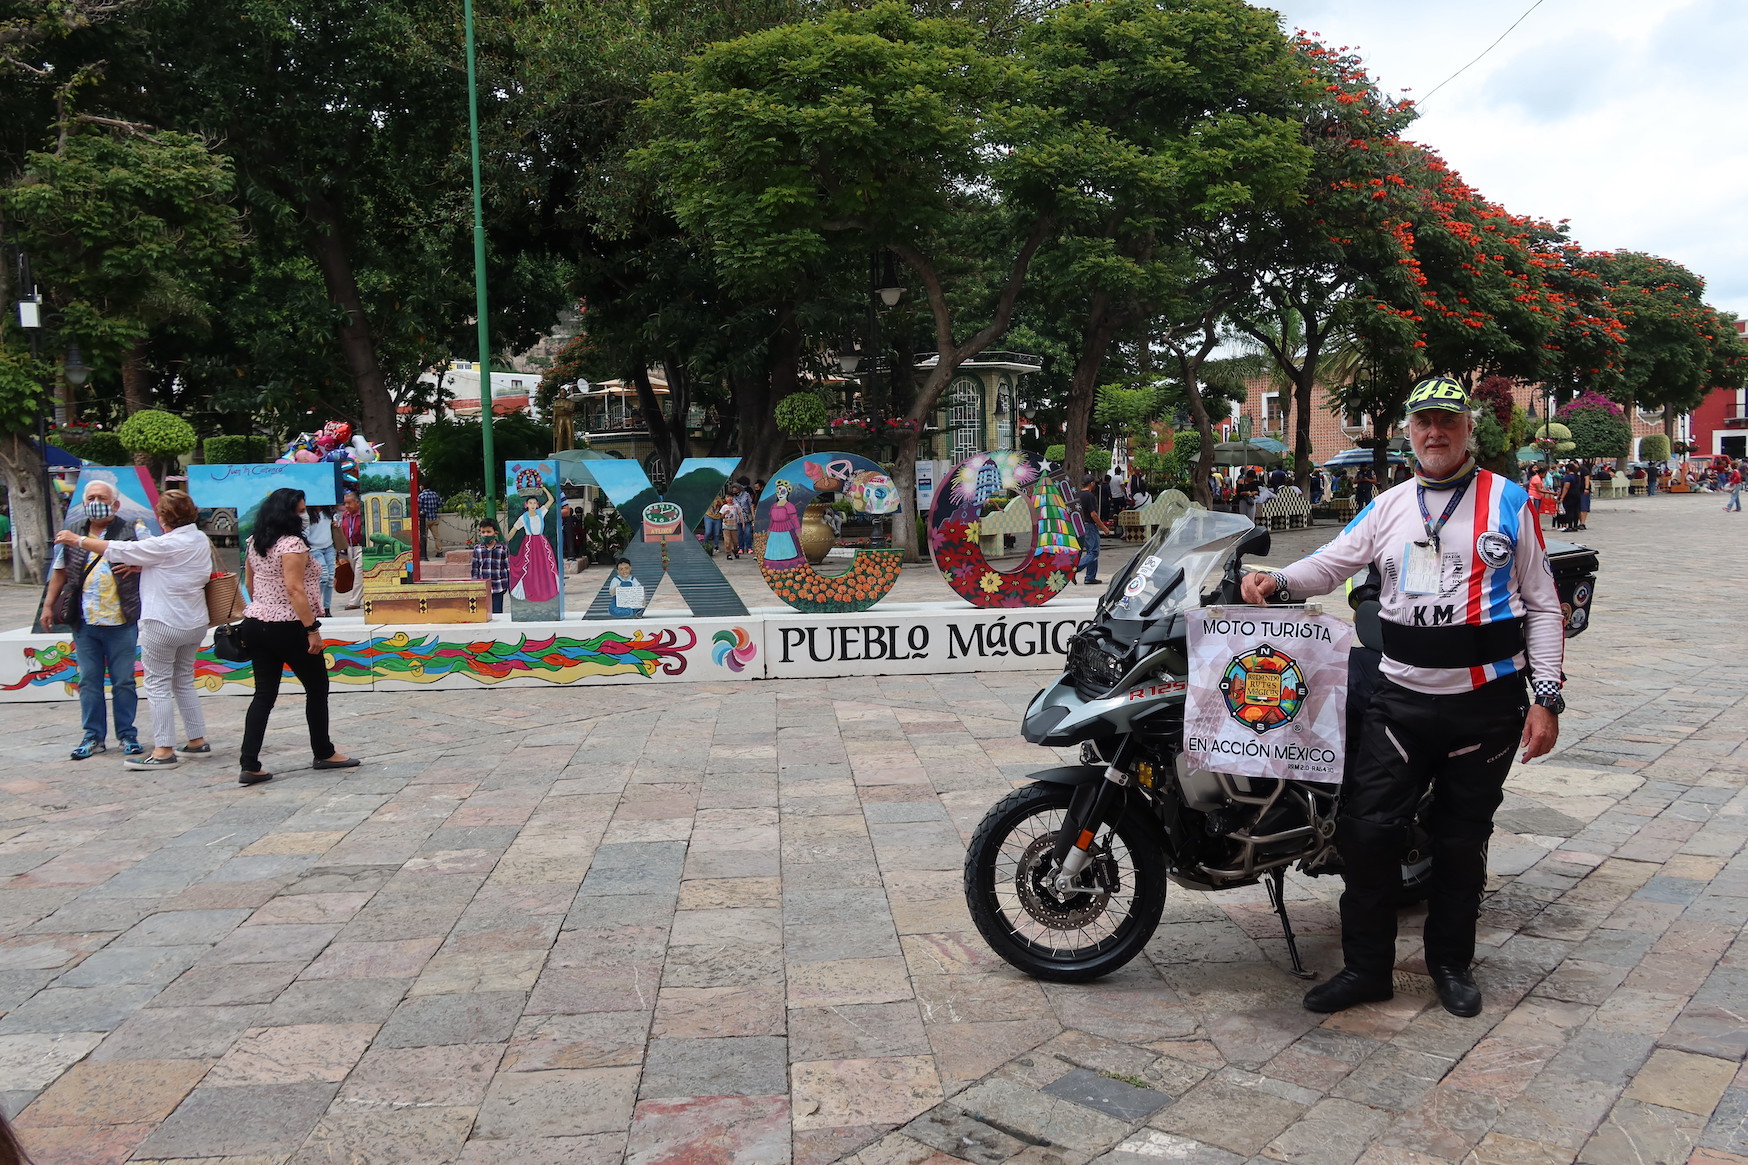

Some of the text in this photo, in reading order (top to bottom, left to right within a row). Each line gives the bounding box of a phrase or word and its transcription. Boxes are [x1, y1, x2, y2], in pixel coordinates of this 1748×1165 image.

[1410, 379, 1463, 402] 46
[1413, 604, 1455, 627] KM
[1203, 619, 1332, 644] MOTO TURISTA
[1129, 680, 1187, 701] R 125
[1298, 687, 1306, 696] E
[1256, 723, 1265, 731] S
[1188, 737, 1336, 763] EN ACCIÓN MÉXICO
